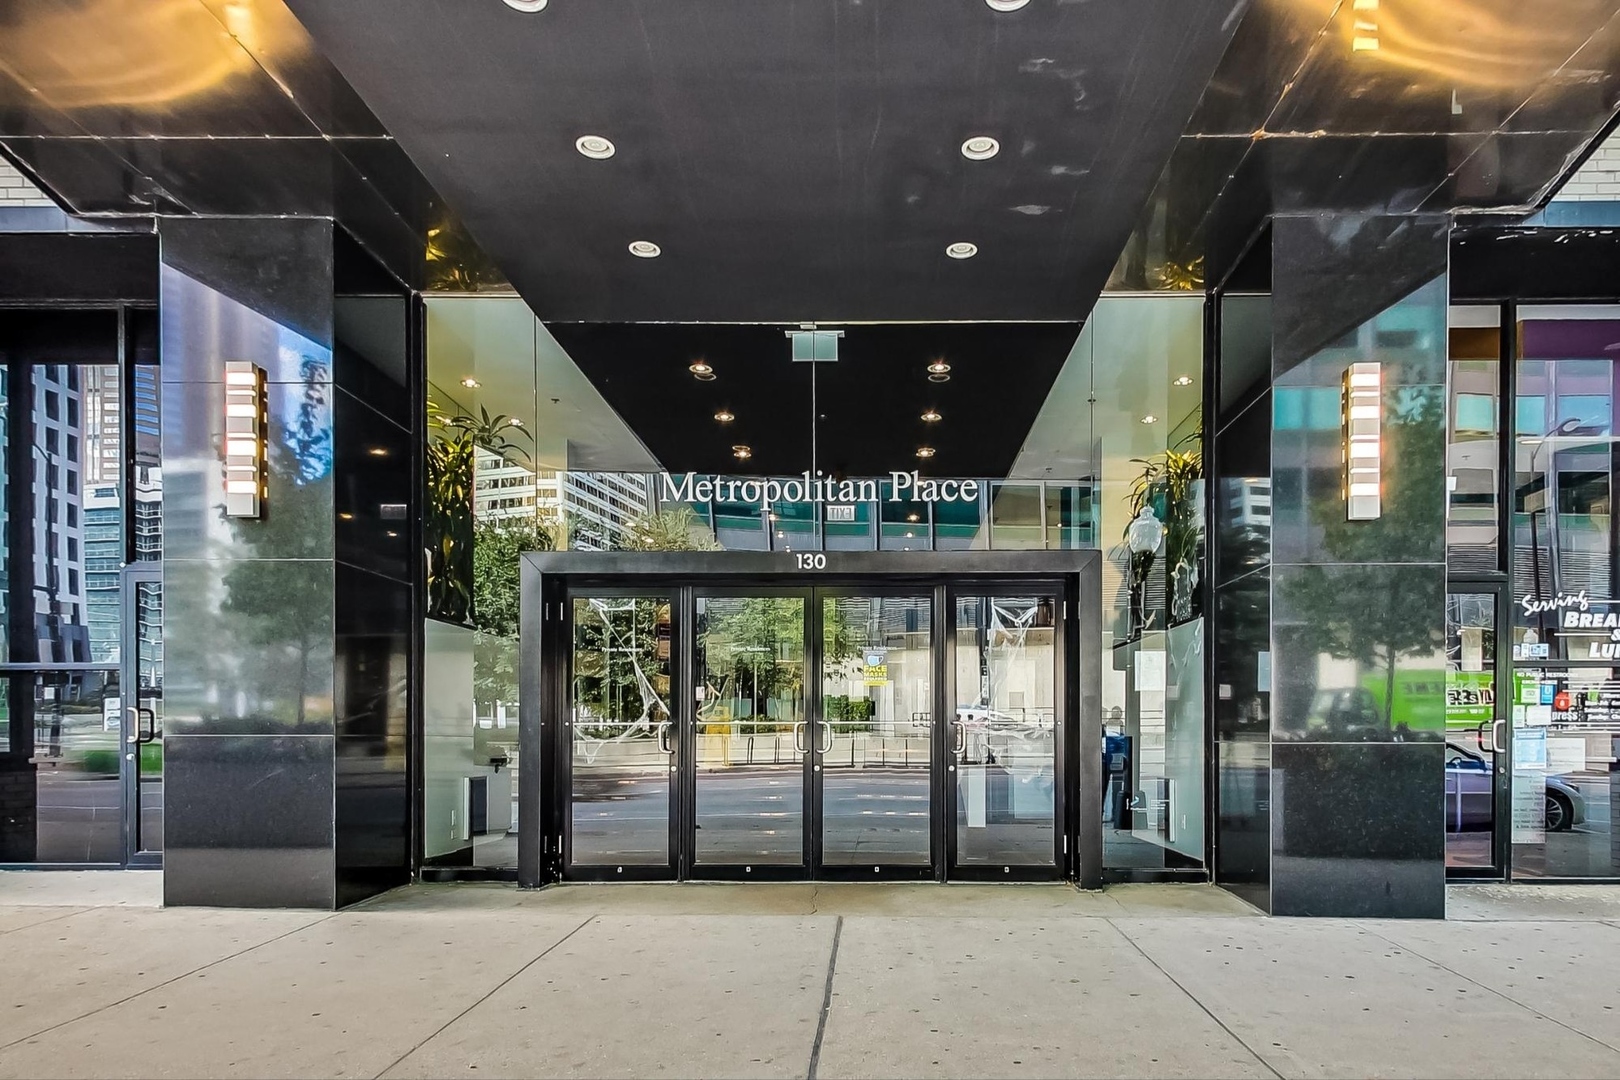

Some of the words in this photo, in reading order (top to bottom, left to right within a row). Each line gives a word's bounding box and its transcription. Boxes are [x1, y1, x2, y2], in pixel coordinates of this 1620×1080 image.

[659, 470, 879, 511] Metropolitan
[889, 470, 978, 502] Place
[796, 553, 826, 570] 130
[1521, 590, 1588, 616] Serving
[1563, 611, 1620, 628] BREA
